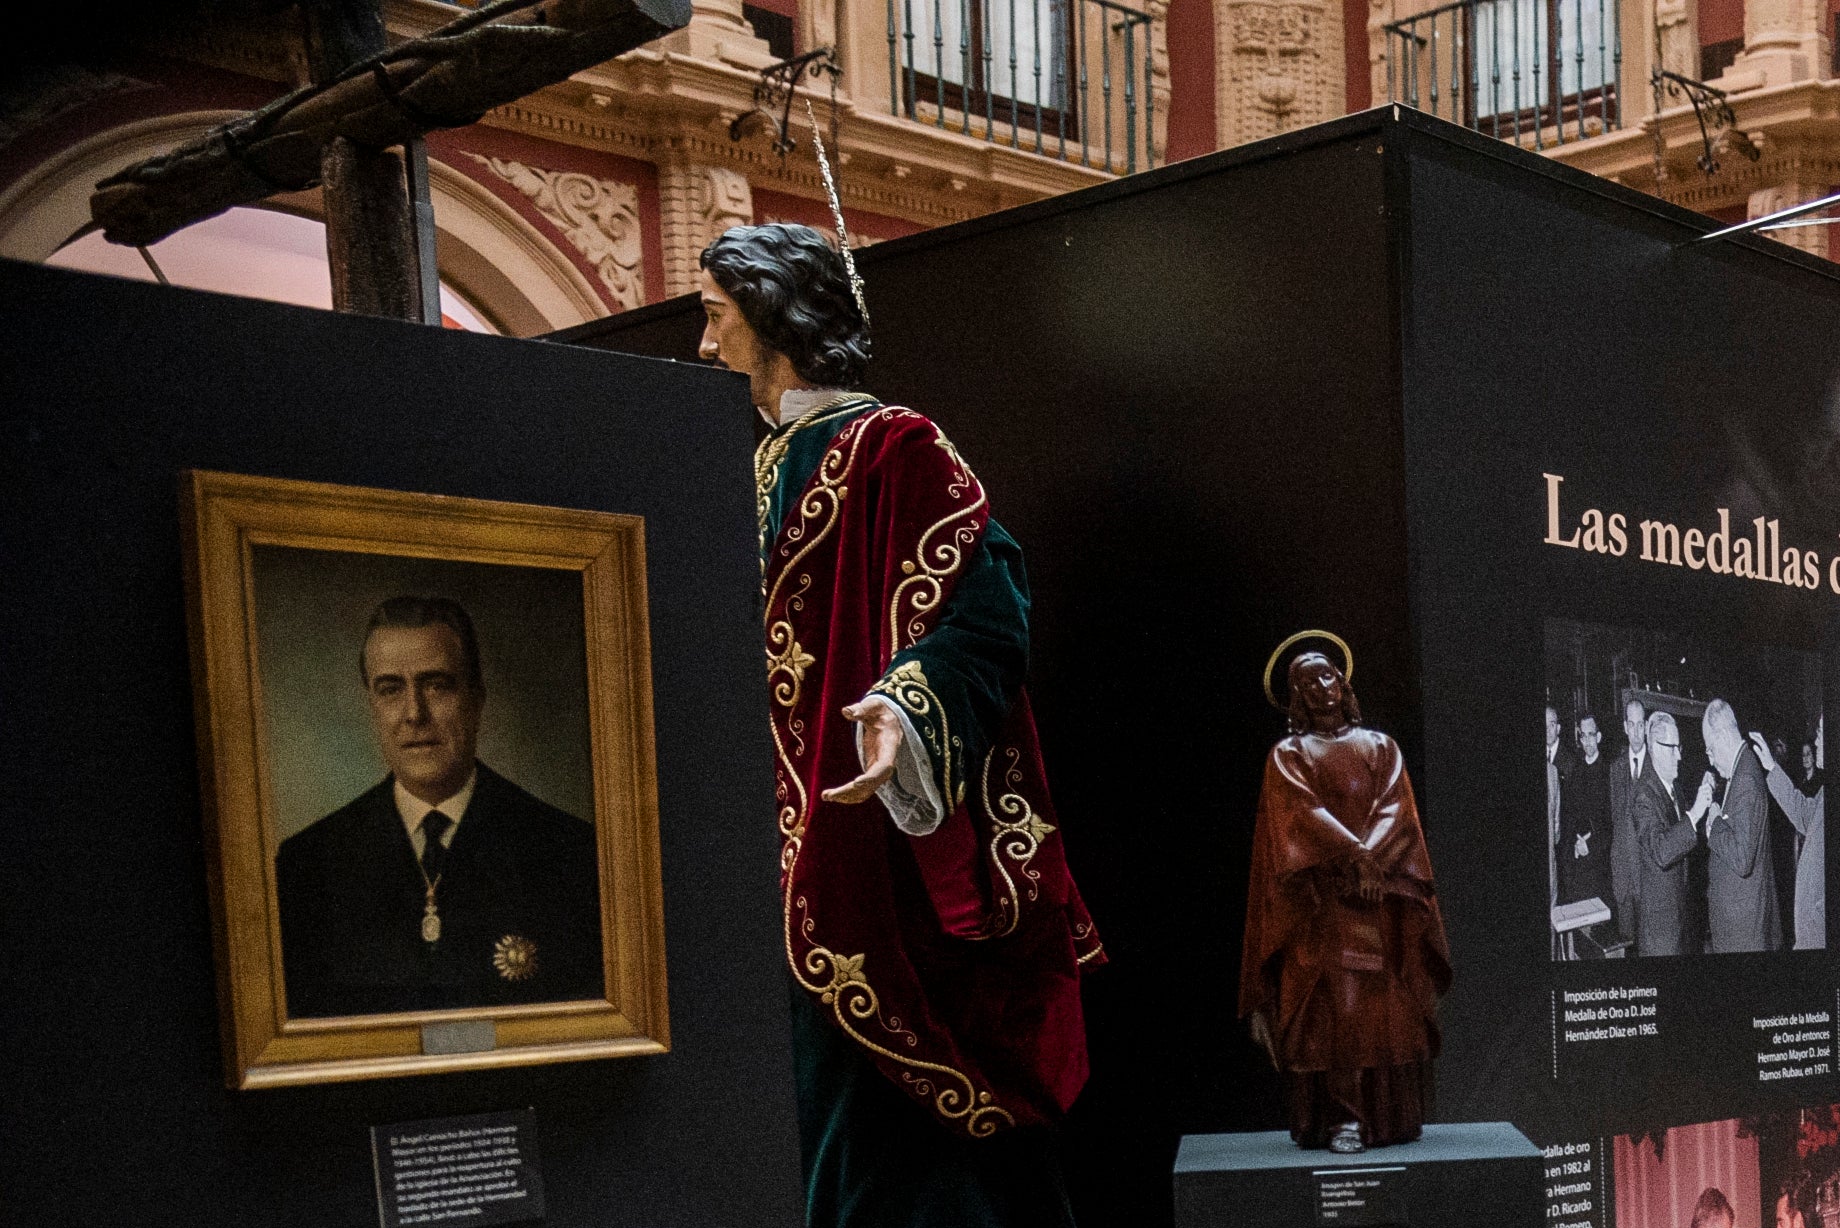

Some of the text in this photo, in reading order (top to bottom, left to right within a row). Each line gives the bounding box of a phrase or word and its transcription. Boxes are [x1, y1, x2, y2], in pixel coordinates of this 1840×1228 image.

[1543, 472, 1628, 556] Las
[1640, 508, 1820, 589] medallas
[1564, 986, 1657, 1004] Imposición de la primera
[1565, 1004, 1656, 1022] Medalla de Oro a D. José
[1754, 1012, 1830, 1030] Imposición de la Medalla
[1566, 1023, 1659, 1042] Hernández Díaz en 1965.
[1773, 1031, 1830, 1044] de Oro al entonces
[1758, 1046, 1831, 1063] Hermano Mayor D. José
[1760, 1064, 1831, 1081] Ramos Rubau, en 1971.
[1542, 1143, 1590, 1158] dalla de oro
[1551, 1167, 1561, 1177] en
[1563, 1162, 1582, 1175] 1982
[1583, 1160, 1591, 1172] al
[1554, 1182, 1592, 1196] Hermano
[1552, 1205, 1561, 1217] D.
[1562, 1199, 1592, 1215] Ricardo
